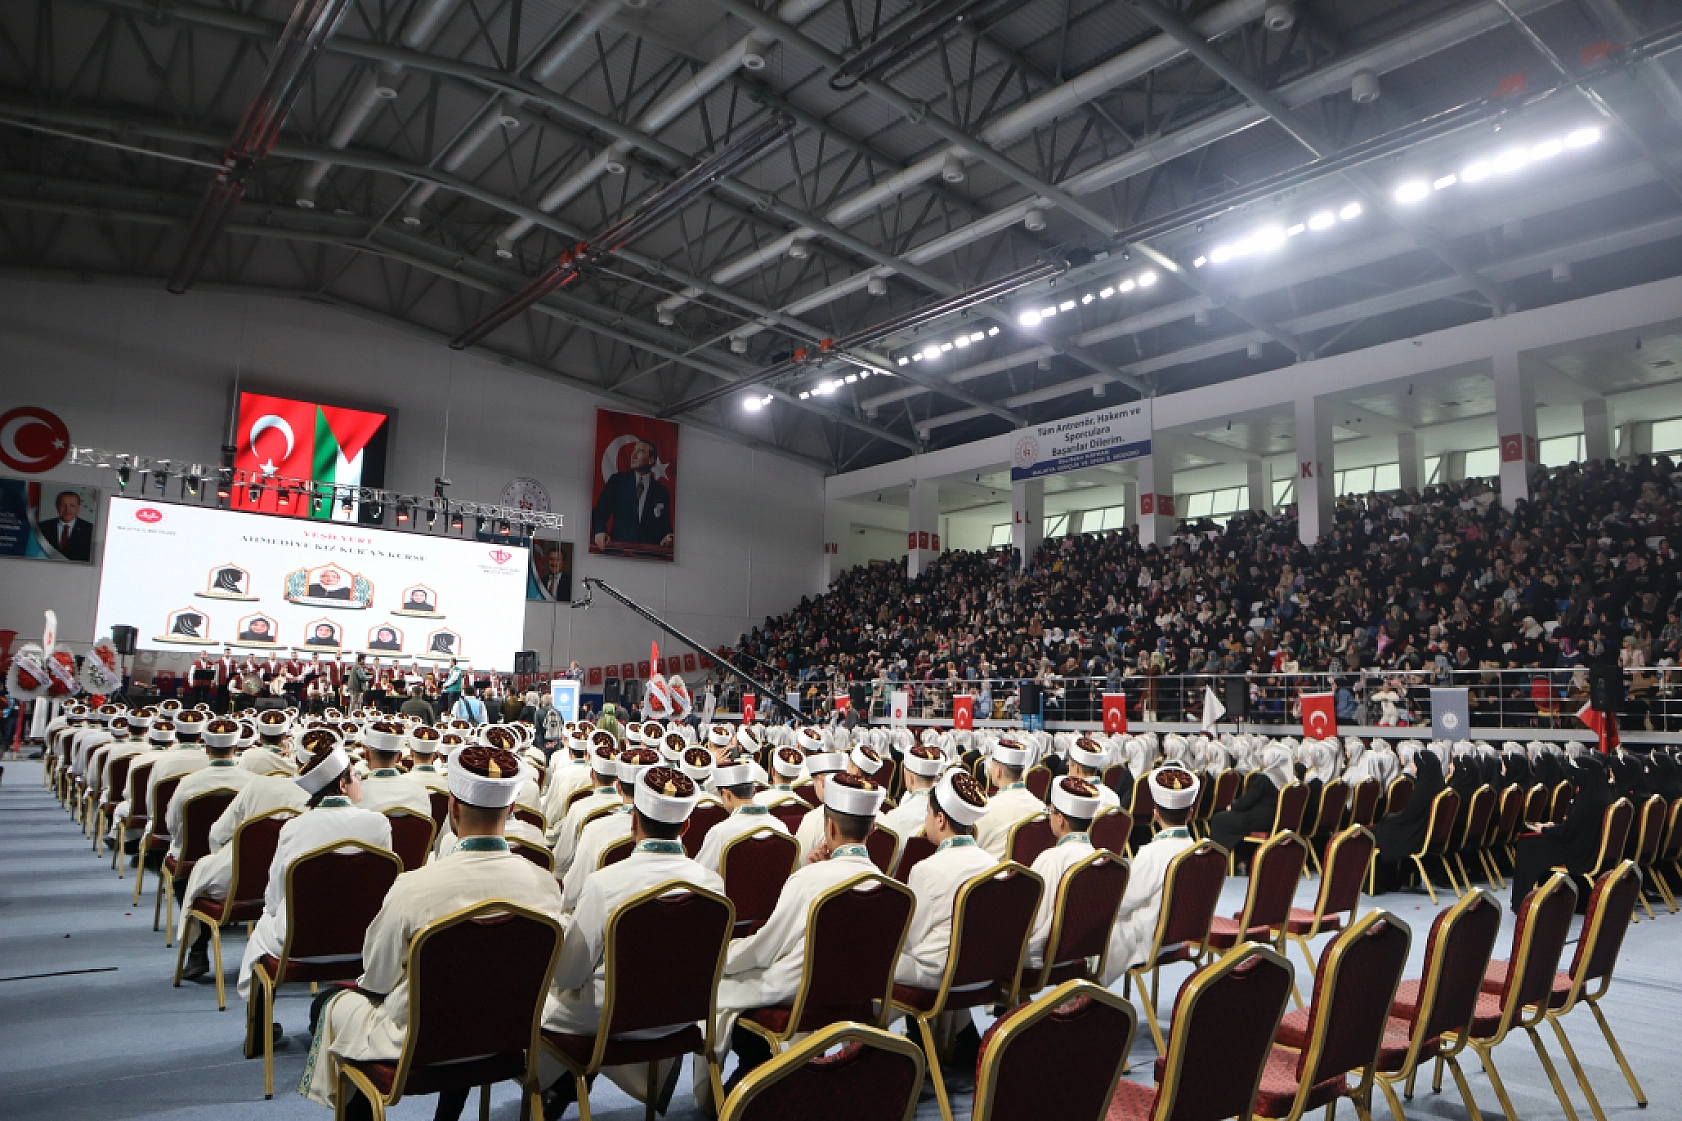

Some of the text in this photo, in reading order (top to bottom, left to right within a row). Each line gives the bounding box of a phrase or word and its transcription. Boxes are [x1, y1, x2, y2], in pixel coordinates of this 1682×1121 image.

[1037, 406, 1142, 437] Tüm Antrenör, Hakem ve
[1089, 434, 1125, 449] Dilerim.
[1301, 461, 1313, 479] K
[1015, 510, 1022, 524] L
[1025, 510, 1032, 524] L
